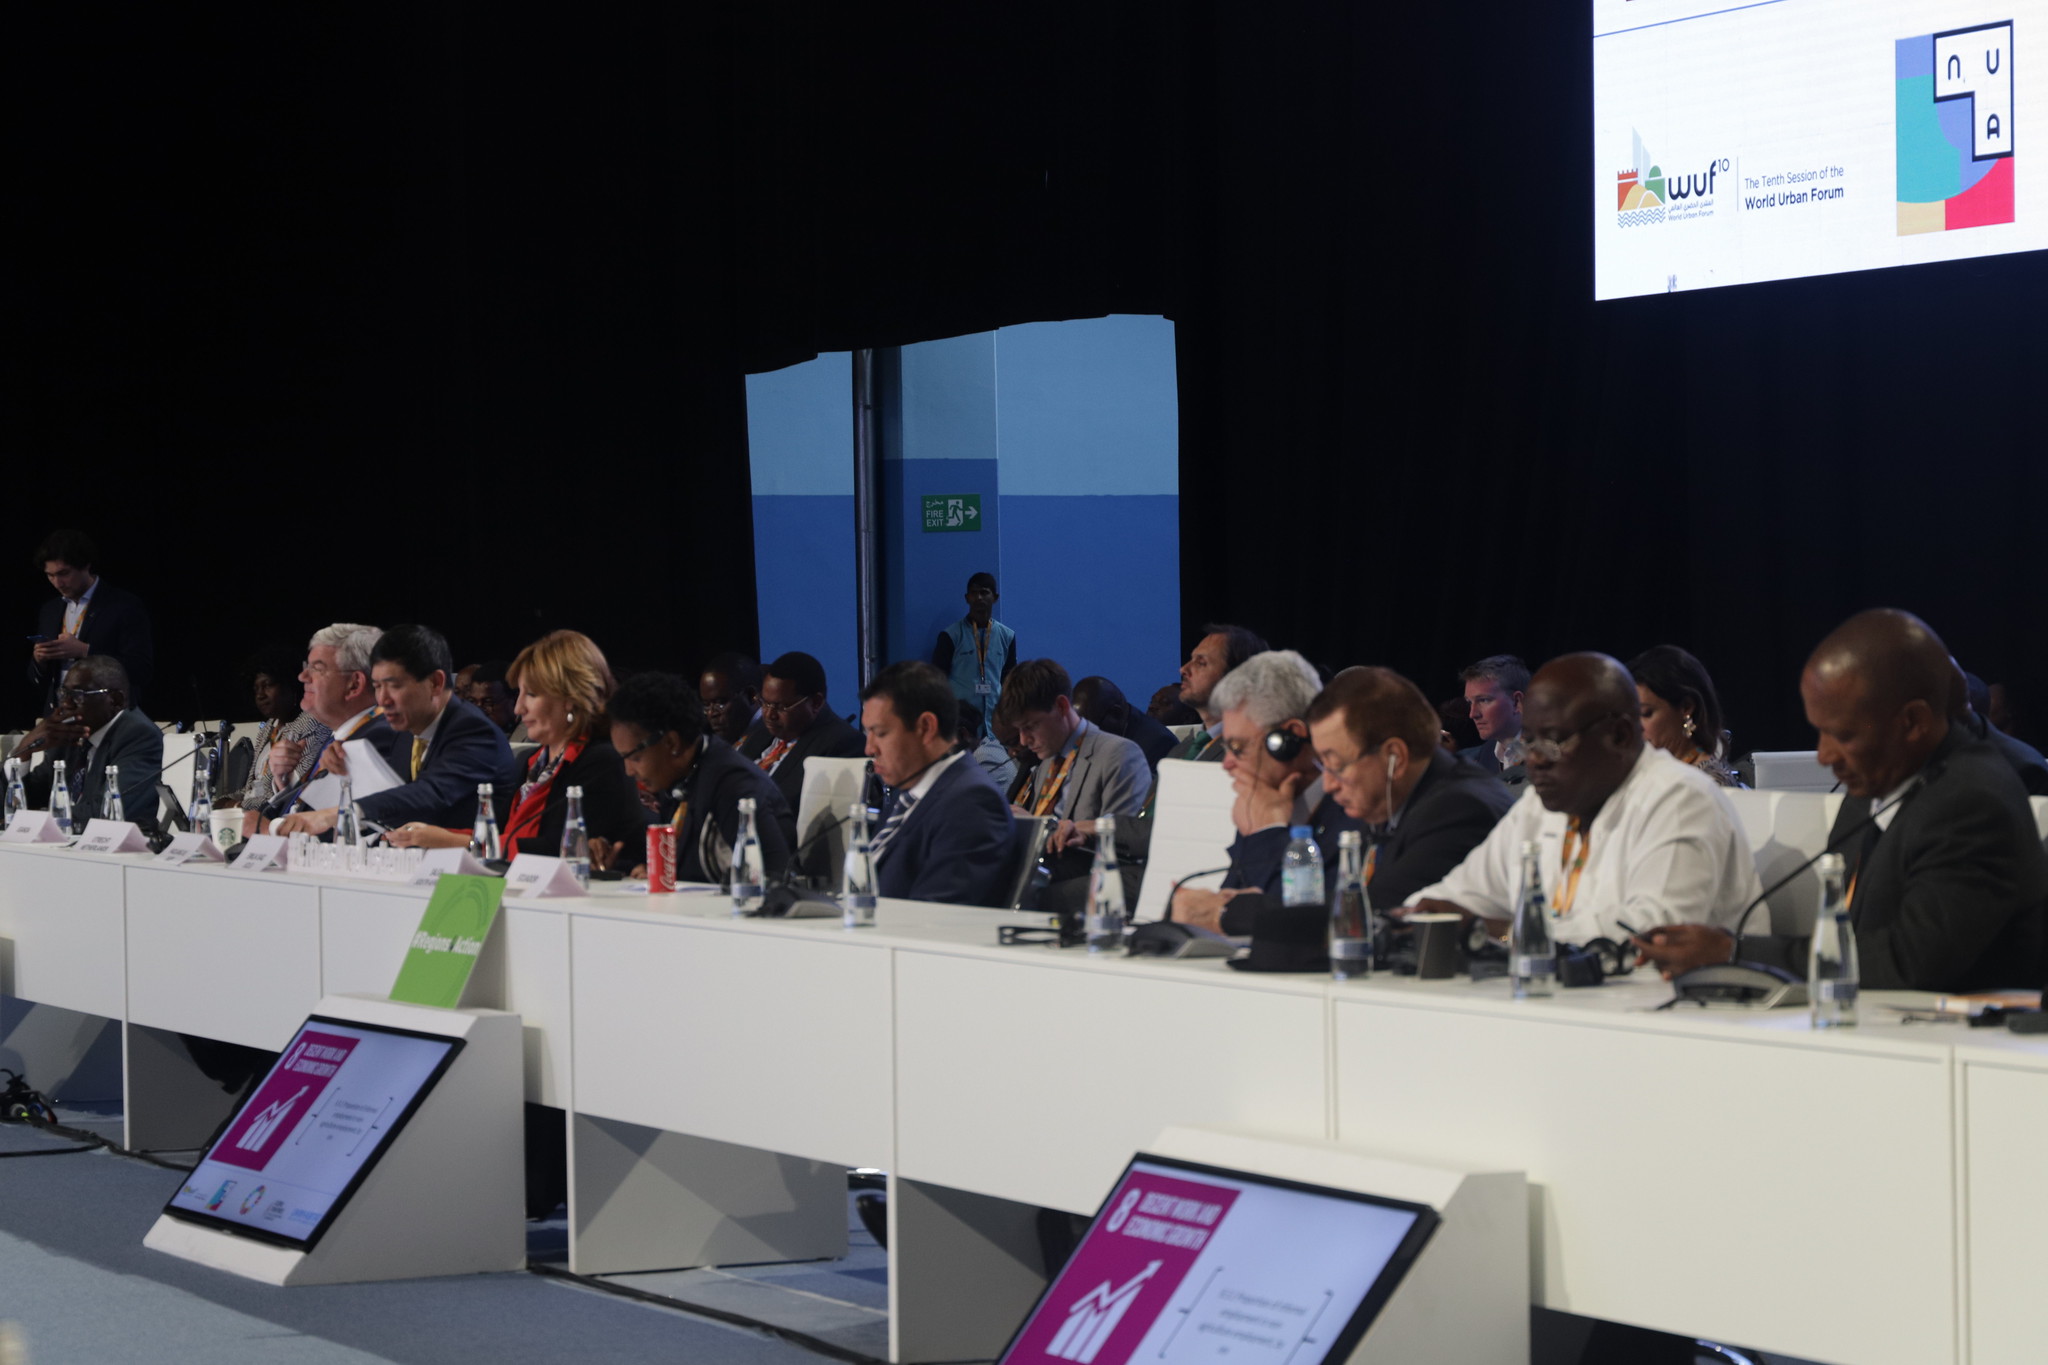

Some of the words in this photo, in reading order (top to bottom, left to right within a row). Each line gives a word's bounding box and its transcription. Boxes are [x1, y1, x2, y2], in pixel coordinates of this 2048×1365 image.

[1744, 177, 1760, 190] The
[1761, 173, 1785, 187] Tenth
[1786, 169, 1818, 184] Session
[1819, 166, 1829, 180] of
[1830, 165, 1844, 178] the
[1744, 193, 1775, 211] World
[1778, 190, 1808, 206] Urban
[1810, 187, 1845, 202] Forum
[926, 510, 943, 518] FIRE
[926, 519, 943, 527] EXIT
[1105, 1187, 1142, 1233] 8
